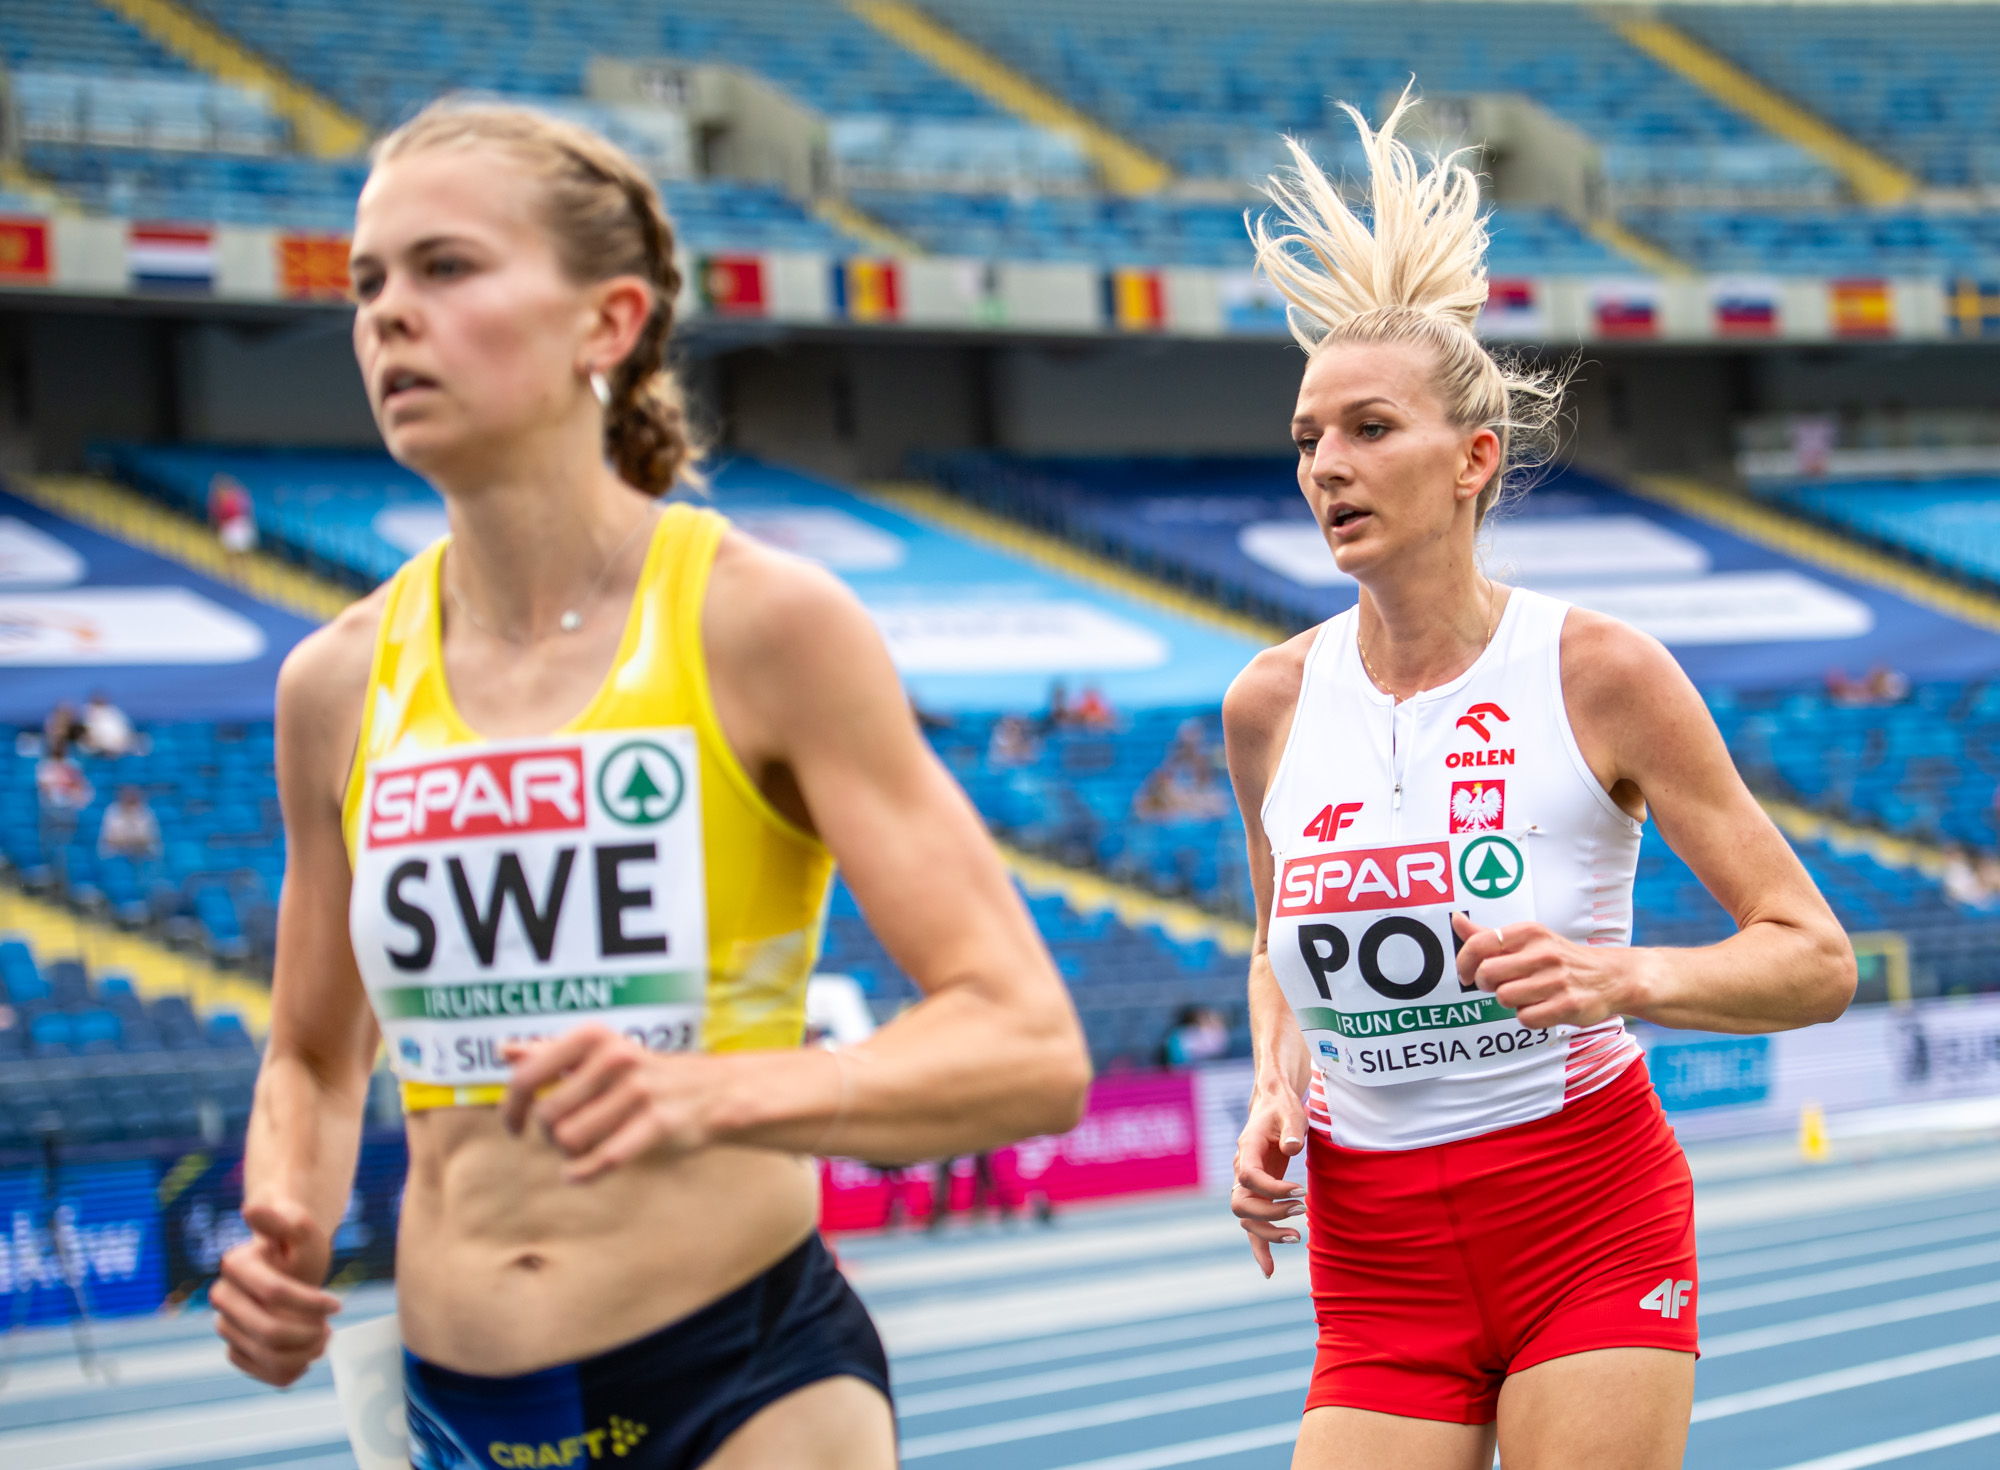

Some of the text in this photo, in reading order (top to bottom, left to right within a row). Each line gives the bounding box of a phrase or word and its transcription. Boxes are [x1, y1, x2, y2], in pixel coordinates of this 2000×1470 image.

[1445, 748, 1516, 769] ORLEN
[369, 755, 581, 841] SPAR
[1302, 801, 1365, 843] 4F
[1281, 850, 1449, 908] SPAR
[383, 842, 668, 974] SWE
[1359, 1028, 1550, 1074] SILESIA 2023
[1638, 1277, 1694, 1320] 4F
[488, 1427, 607, 1469] CRAFT
